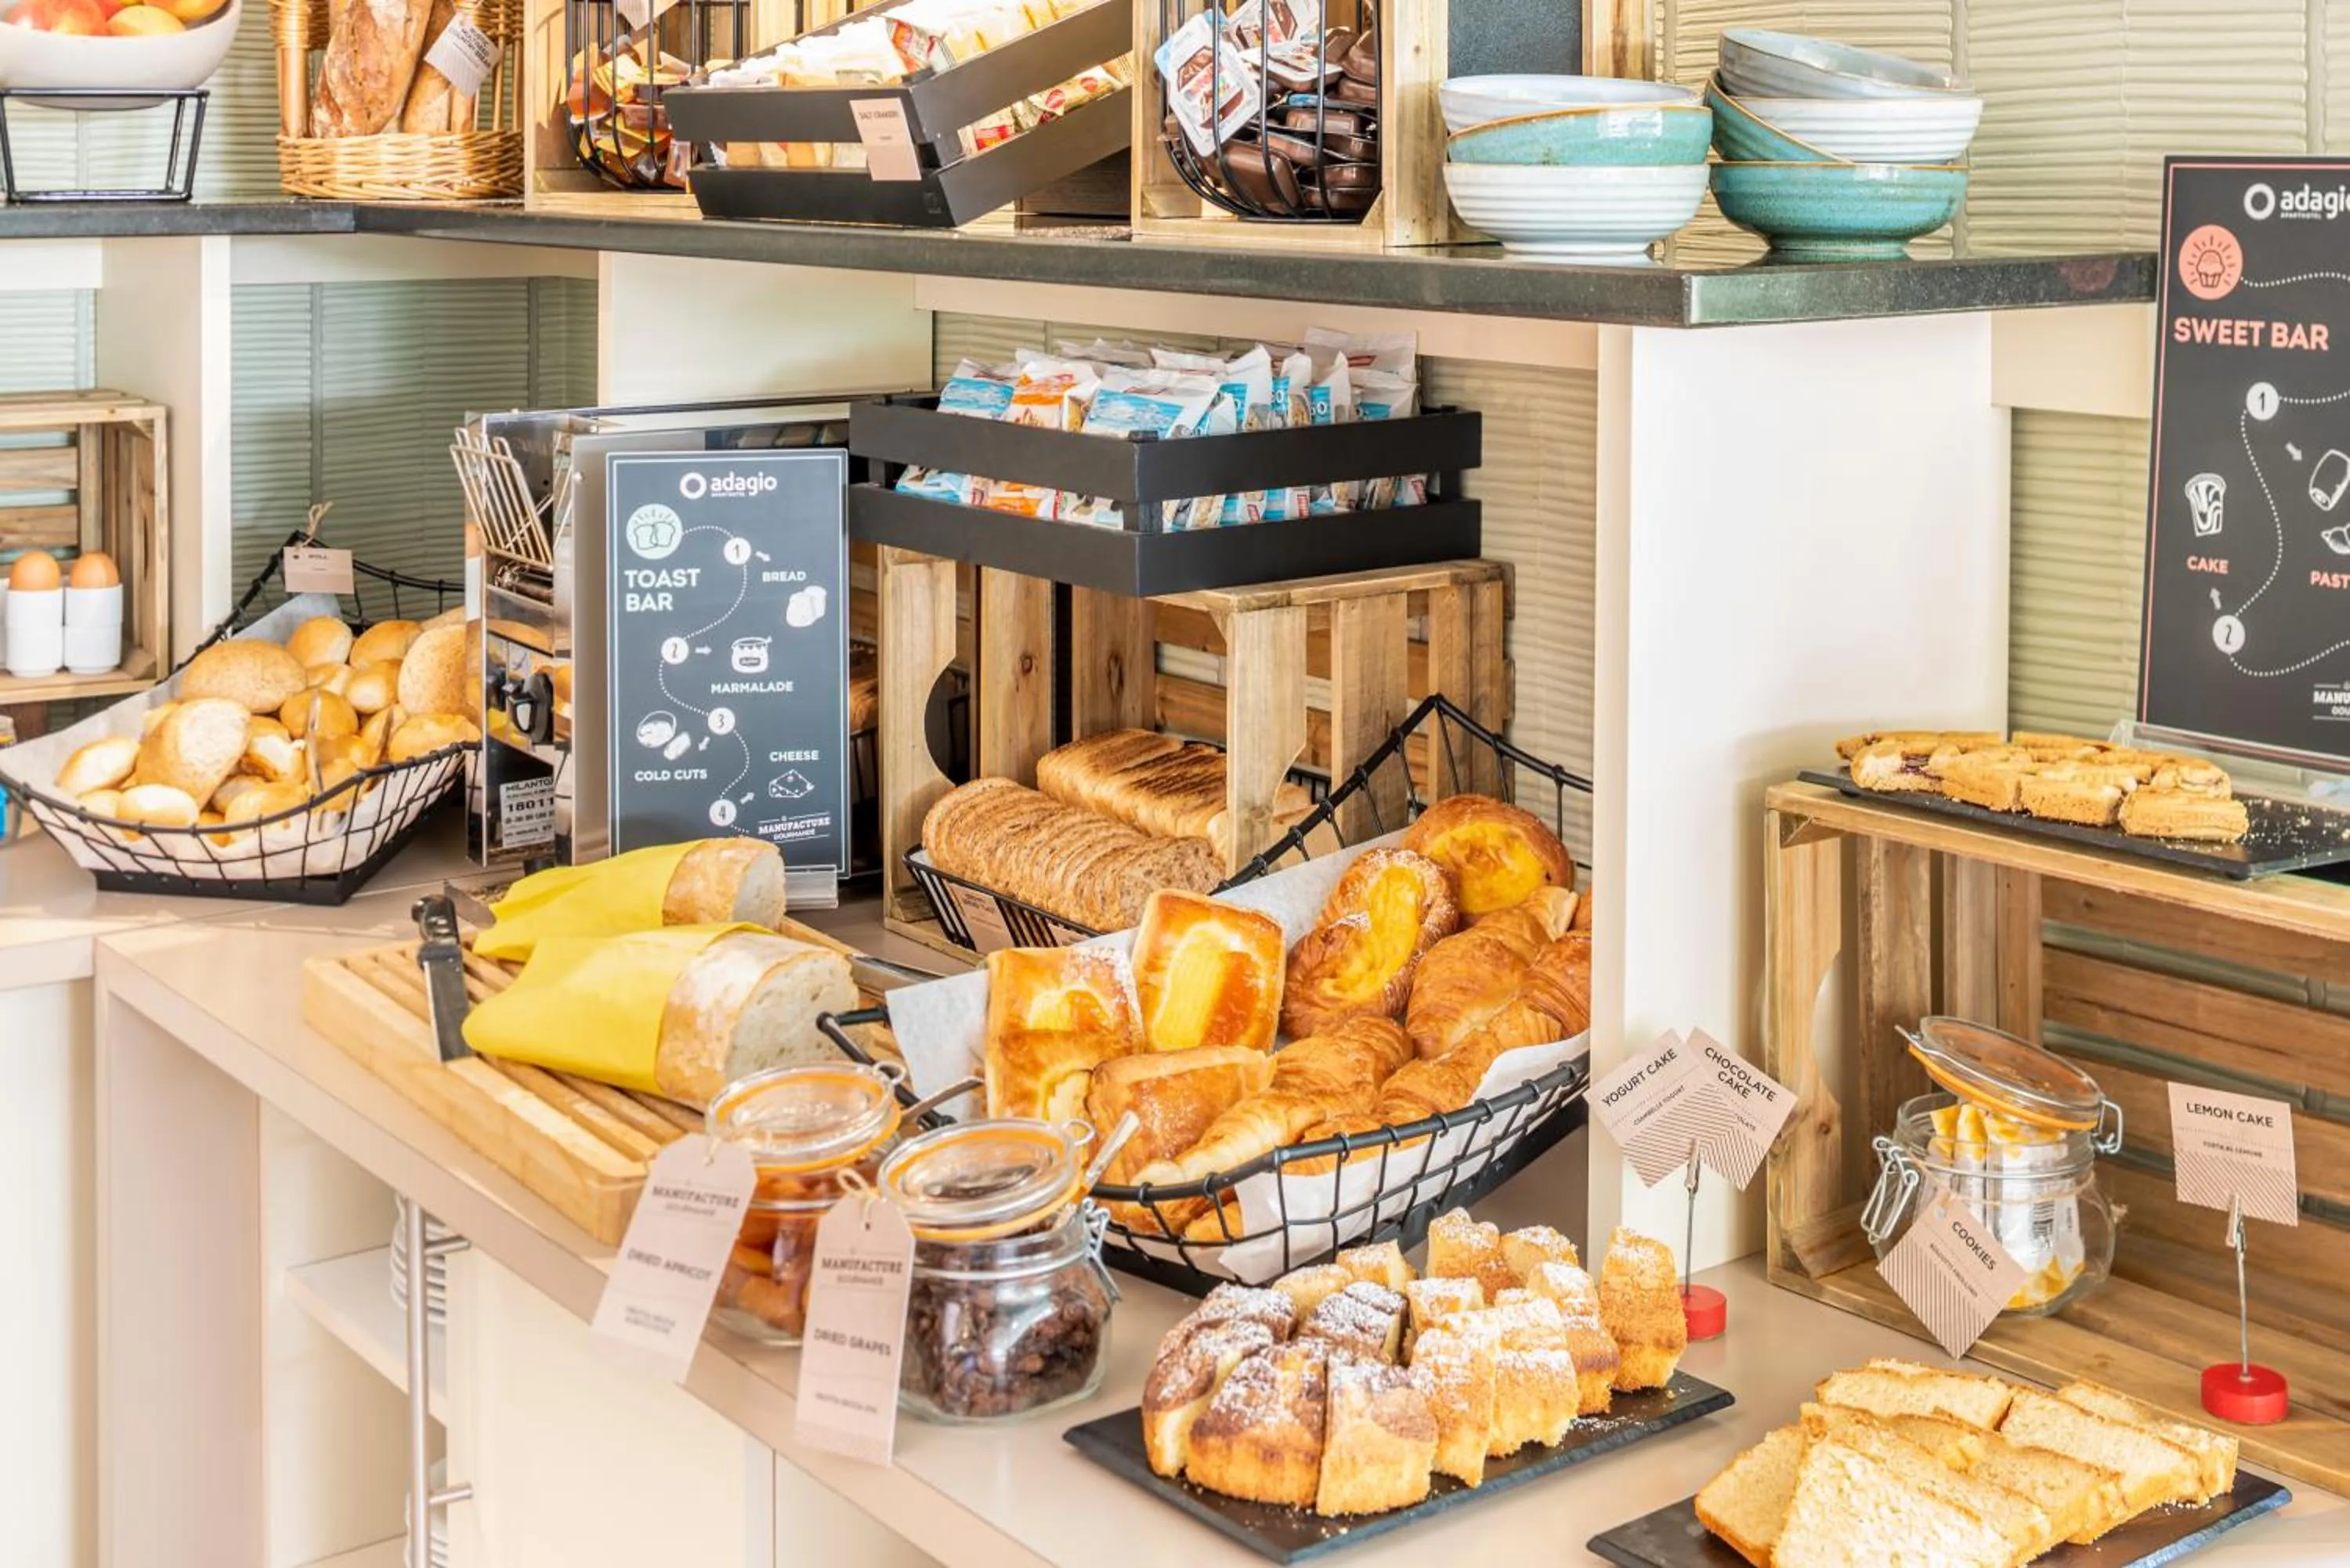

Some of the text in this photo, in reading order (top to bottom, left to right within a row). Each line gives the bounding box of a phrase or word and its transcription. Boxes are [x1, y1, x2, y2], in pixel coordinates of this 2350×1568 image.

[2174, 317, 2329, 351] SWEET BAR
[710, 471, 777, 496] adagio
[762, 571, 807, 582] BREAD
[2186, 555, 2229, 575] CAKE
[624, 569, 700, 588] TOAST
[626, 592, 673, 612] BAR
[710, 681, 794, 694] MARMALADE
[769, 750, 819, 762] CHEESE
[634, 768, 708, 782] COLD CUTS
[758, 817, 831, 835] MANUFACTURE
[1601, 1048, 1678, 1107] YOGURT CAKE
[1705, 1046, 1777, 1102] CHOCOLATE
[1718, 1071, 1752, 1100] CAKE
[2186, 1102, 2274, 1129] LEMON CAKE
[652, 1185, 739, 1209] MANUFACTURE
[1952, 1221, 1997, 1270] COOKIES
[627, 1248, 712, 1281] DRIED APRICOT
[822, 1257, 902, 1274] MANUFACTURE
[814, 1328, 891, 1357] DRIED GRAPES
